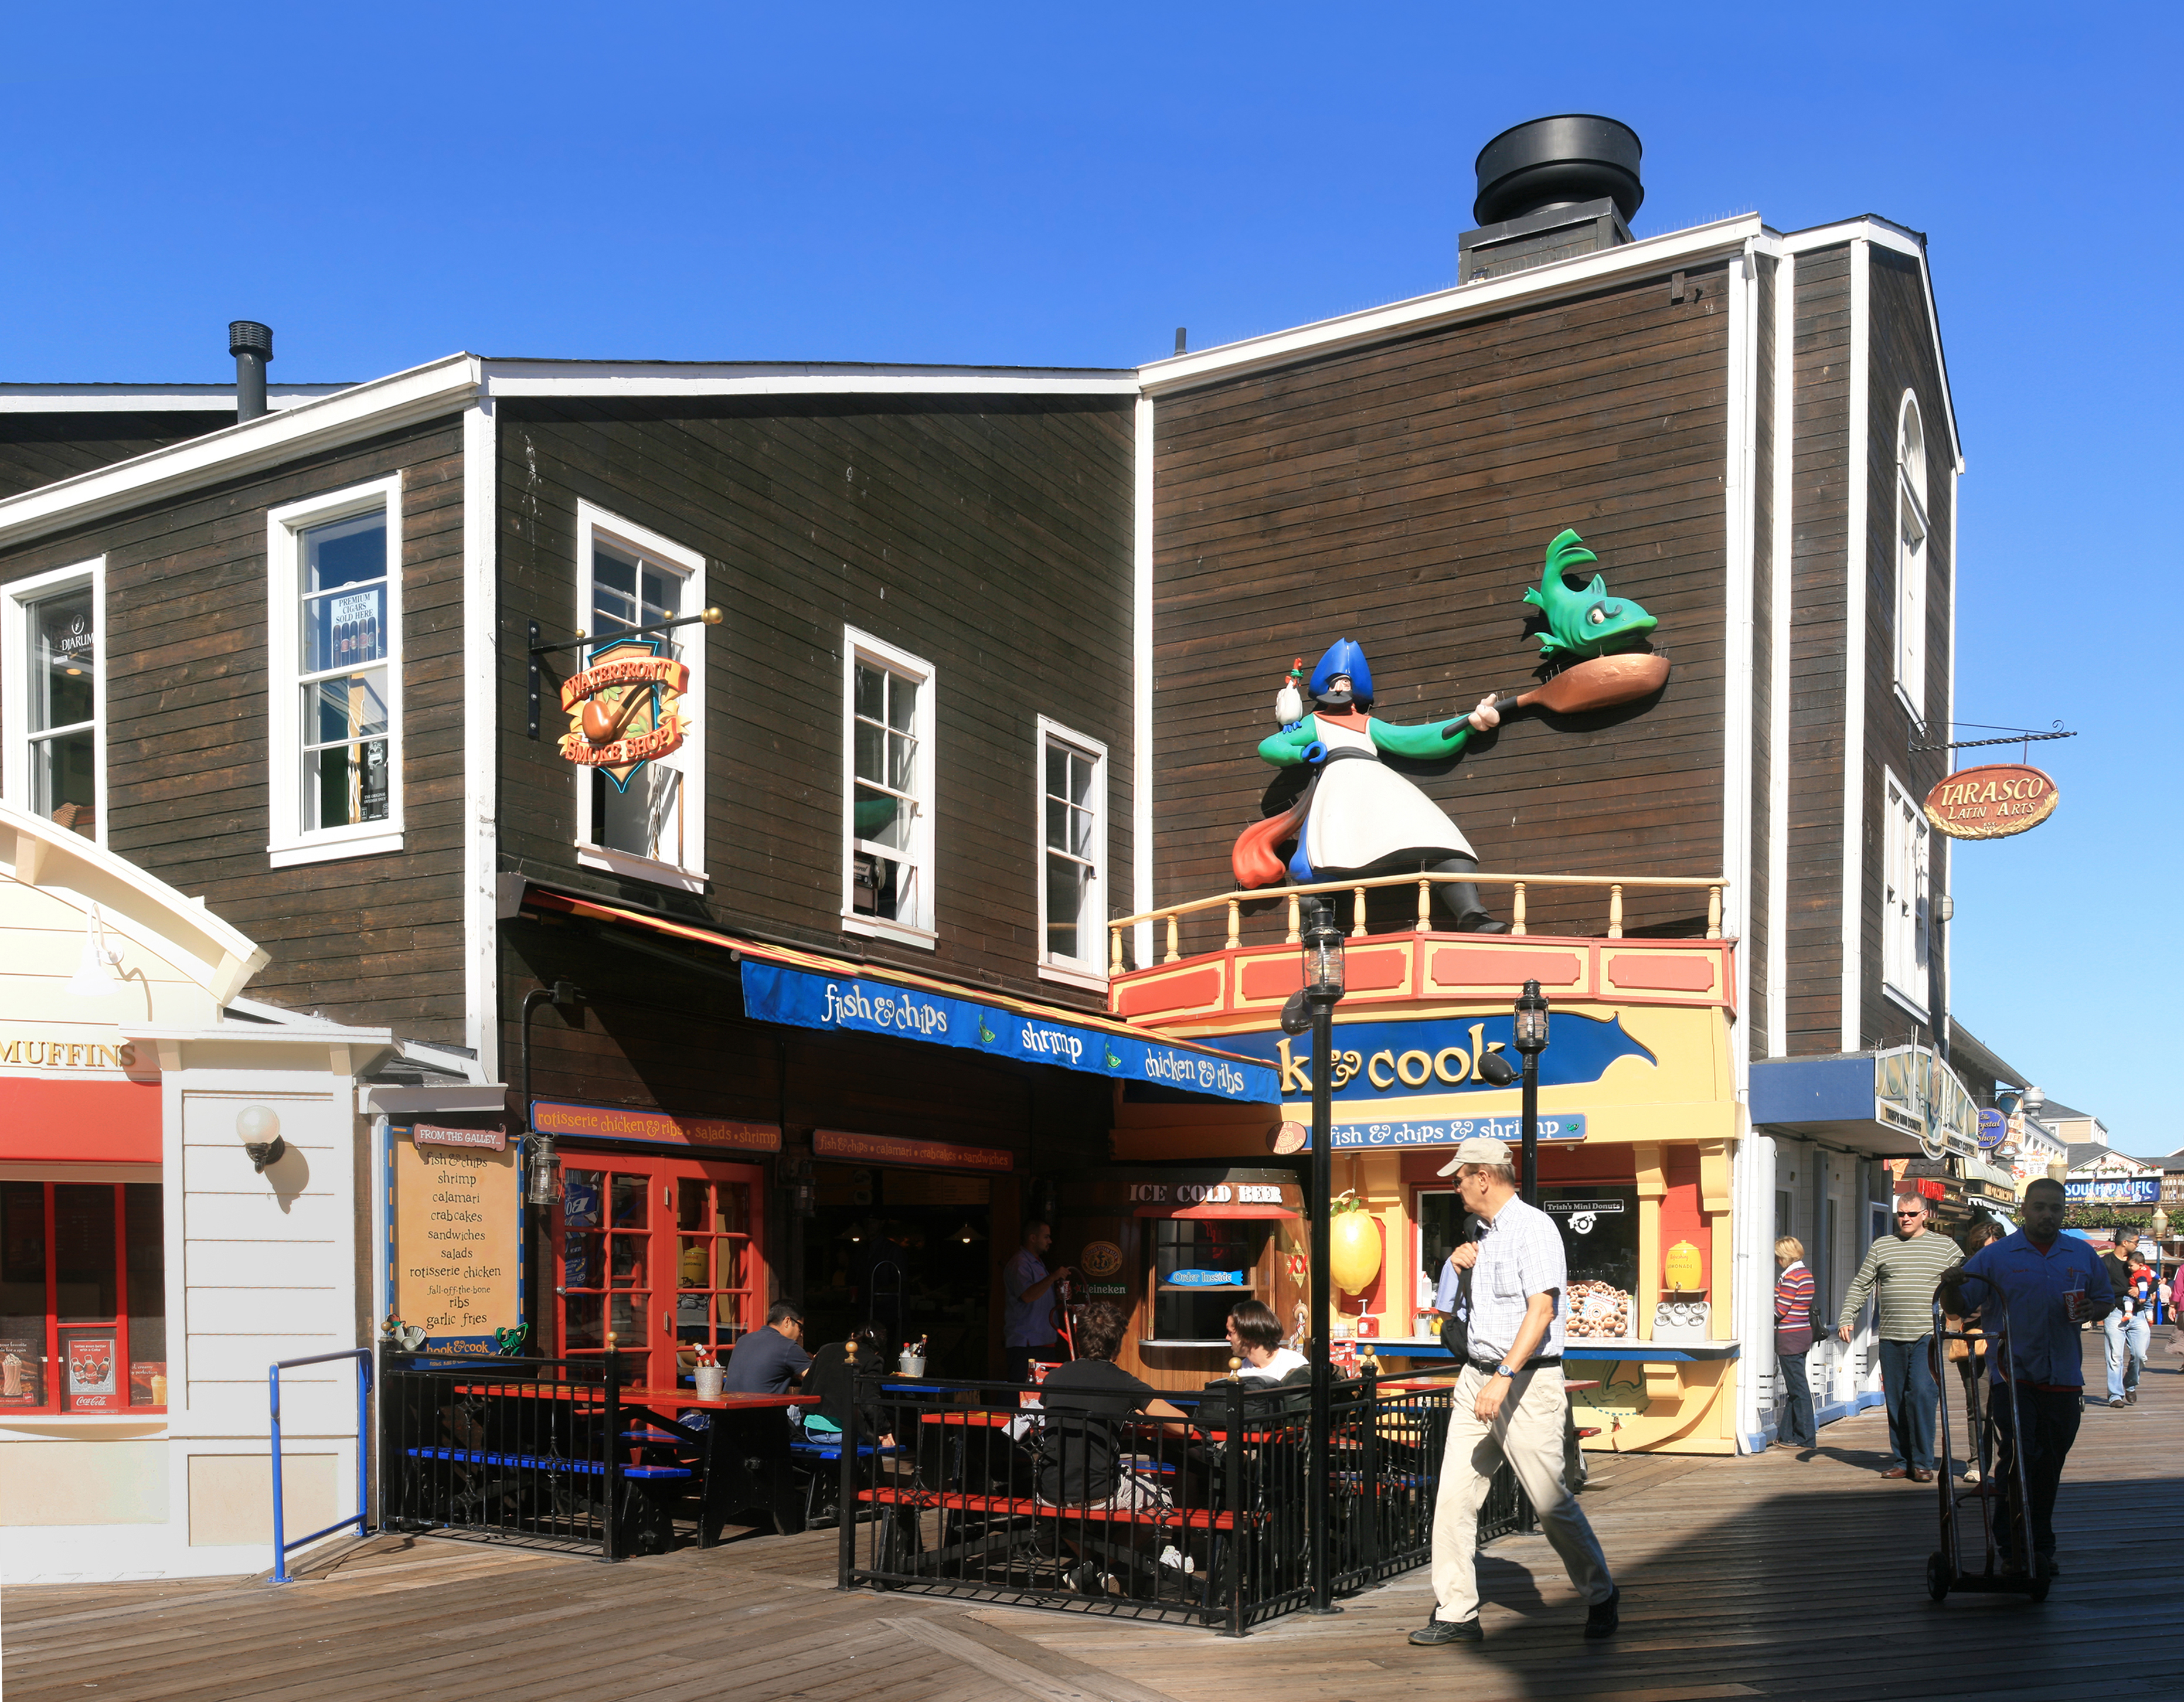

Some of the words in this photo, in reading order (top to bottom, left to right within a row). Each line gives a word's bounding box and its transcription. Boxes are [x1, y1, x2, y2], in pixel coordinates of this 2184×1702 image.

[339, 593, 370, 607] PREMIUM
[342, 602, 367, 614] CIGARS
[336, 614, 353, 624] SOLD
[355, 608, 374, 619] HERE
[62, 632, 94, 651] DJARUM
[564, 661, 672, 697] WATERFRONT
[565, 739, 622, 763] SMOKE
[625, 729, 670, 757] SHOP
[1941, 777, 2044, 806] TARASCO
[1947, 806, 1987, 821] LATIN
[1996, 801, 2036, 817] ARTS
[821, 984, 873, 1024] fish
[896, 994, 947, 1034] chips
[1022, 1022, 1083, 1064] shrimp
[1145, 1048, 1196, 1082] chicken
[1198, 1060, 1216, 1088] &
[1217, 1063, 1244, 1094] ribs
[538, 1111, 598, 1128] rotisserie
[600, 1115, 645, 1133] chicken
[646, 1120, 660, 1137] &
[661, 1120, 683, 1137] ribs
[695, 1125, 732, 1142] salads
[739, 1126, 777, 1148] shrimp
[1979, 1117, 2002, 1132] rystal
[2008, 1119, 2022, 1129] TEA
[420, 1129, 445, 1140] FROM
[447, 1131, 464, 1142] THE
[1331, 1126, 1364, 1146] fish
[1369, 1124, 1391, 1143] &
[1394, 1123, 1444, 1144] chips
[1450, 1121, 1474, 1141] &
[819, 1135, 837, 1150] fish
[848, 1139, 868, 1153] chips
[876, 1143, 913, 1158] calamari
[963, 1150, 1009, 1166] sandwiches
[1273, 1138, 1304, 1154] BATTERED
[423, 1152, 447, 1166] fish
[461, 1155, 488, 1169] chips
[437, 1170, 477, 1187] shrimp
[1129, 1184, 1168, 1201] ICE
[1176, 1184, 1232, 1203] COLD
[1237, 1185, 1282, 1203] BEER
[2065, 1183, 2104, 1196] SOUTH
[2108, 1181, 2154, 1196] PACIFIC
[432, 1191, 480, 1204] calamari
[428, 1228, 486, 1241] sandwiches
[441, 1247, 473, 1260] salads
[1097, 1245, 1110, 1254] STEAM
[410, 1266, 460, 1278] rotisserie
[463, 1265, 502, 1279] chicken
[1173, 1271, 1200, 1282] Order
[427, 1285, 491, 1296] fall-off-the-bone
[450, 1296, 470, 1309] ribs
[426, 1312, 457, 1330] garlic
[460, 1313, 488, 1327] fries
[464, 1340, 491, 1353] cook
